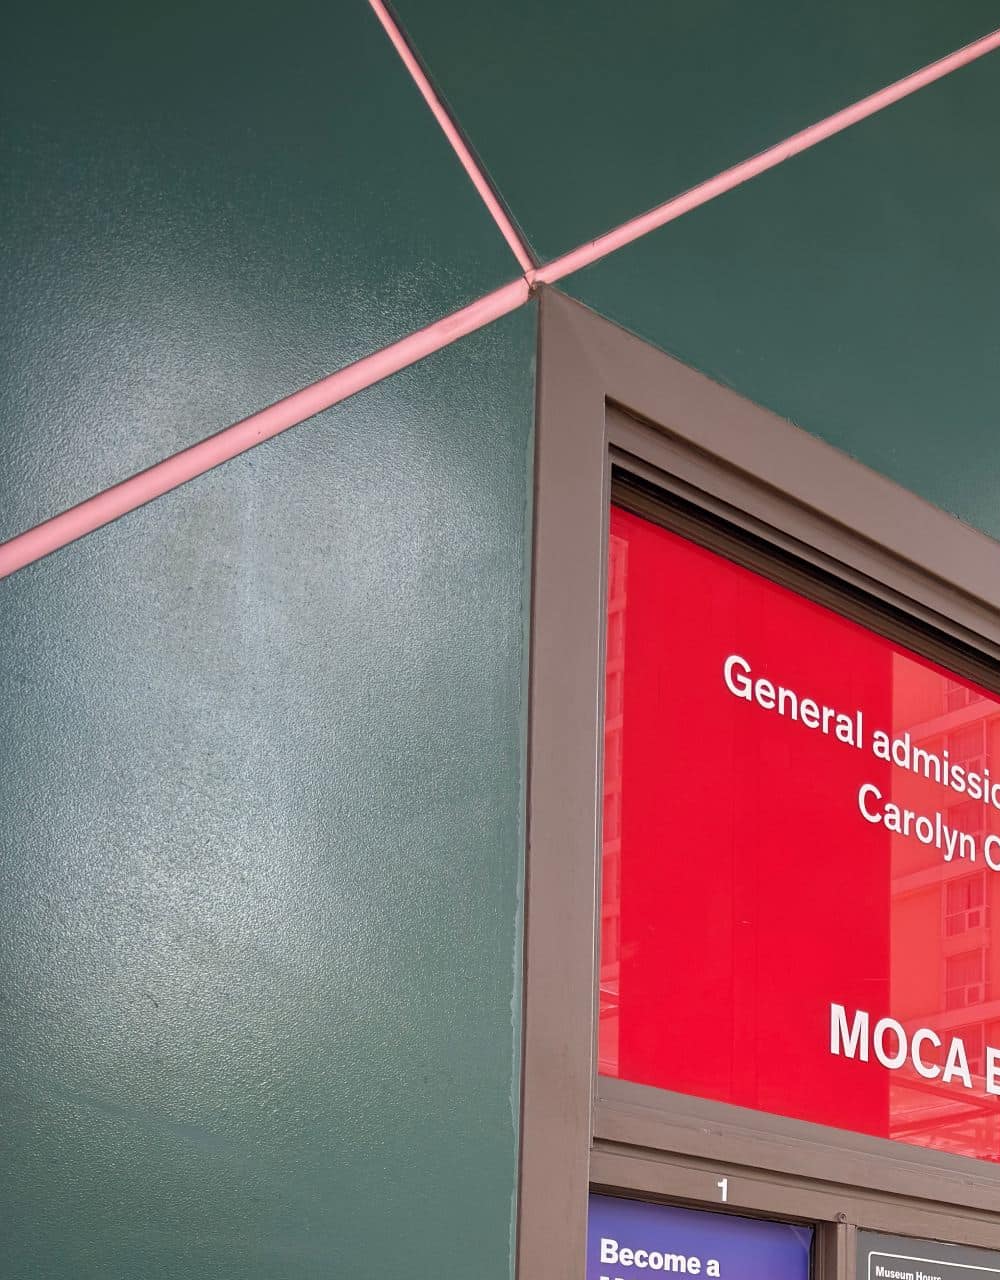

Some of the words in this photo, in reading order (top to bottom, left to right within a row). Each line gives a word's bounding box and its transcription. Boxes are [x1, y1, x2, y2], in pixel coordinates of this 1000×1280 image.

[723, 655, 863, 749] General
[857, 783, 976, 864] Carolyn
[829, 1002, 974, 1089] MOCA
[717, 1178, 728, 1201] 1
[600, 1238, 701, 1274] Become
[707, 1259, 720, 1277] a
[876, 1266, 913, 1280] Museum
